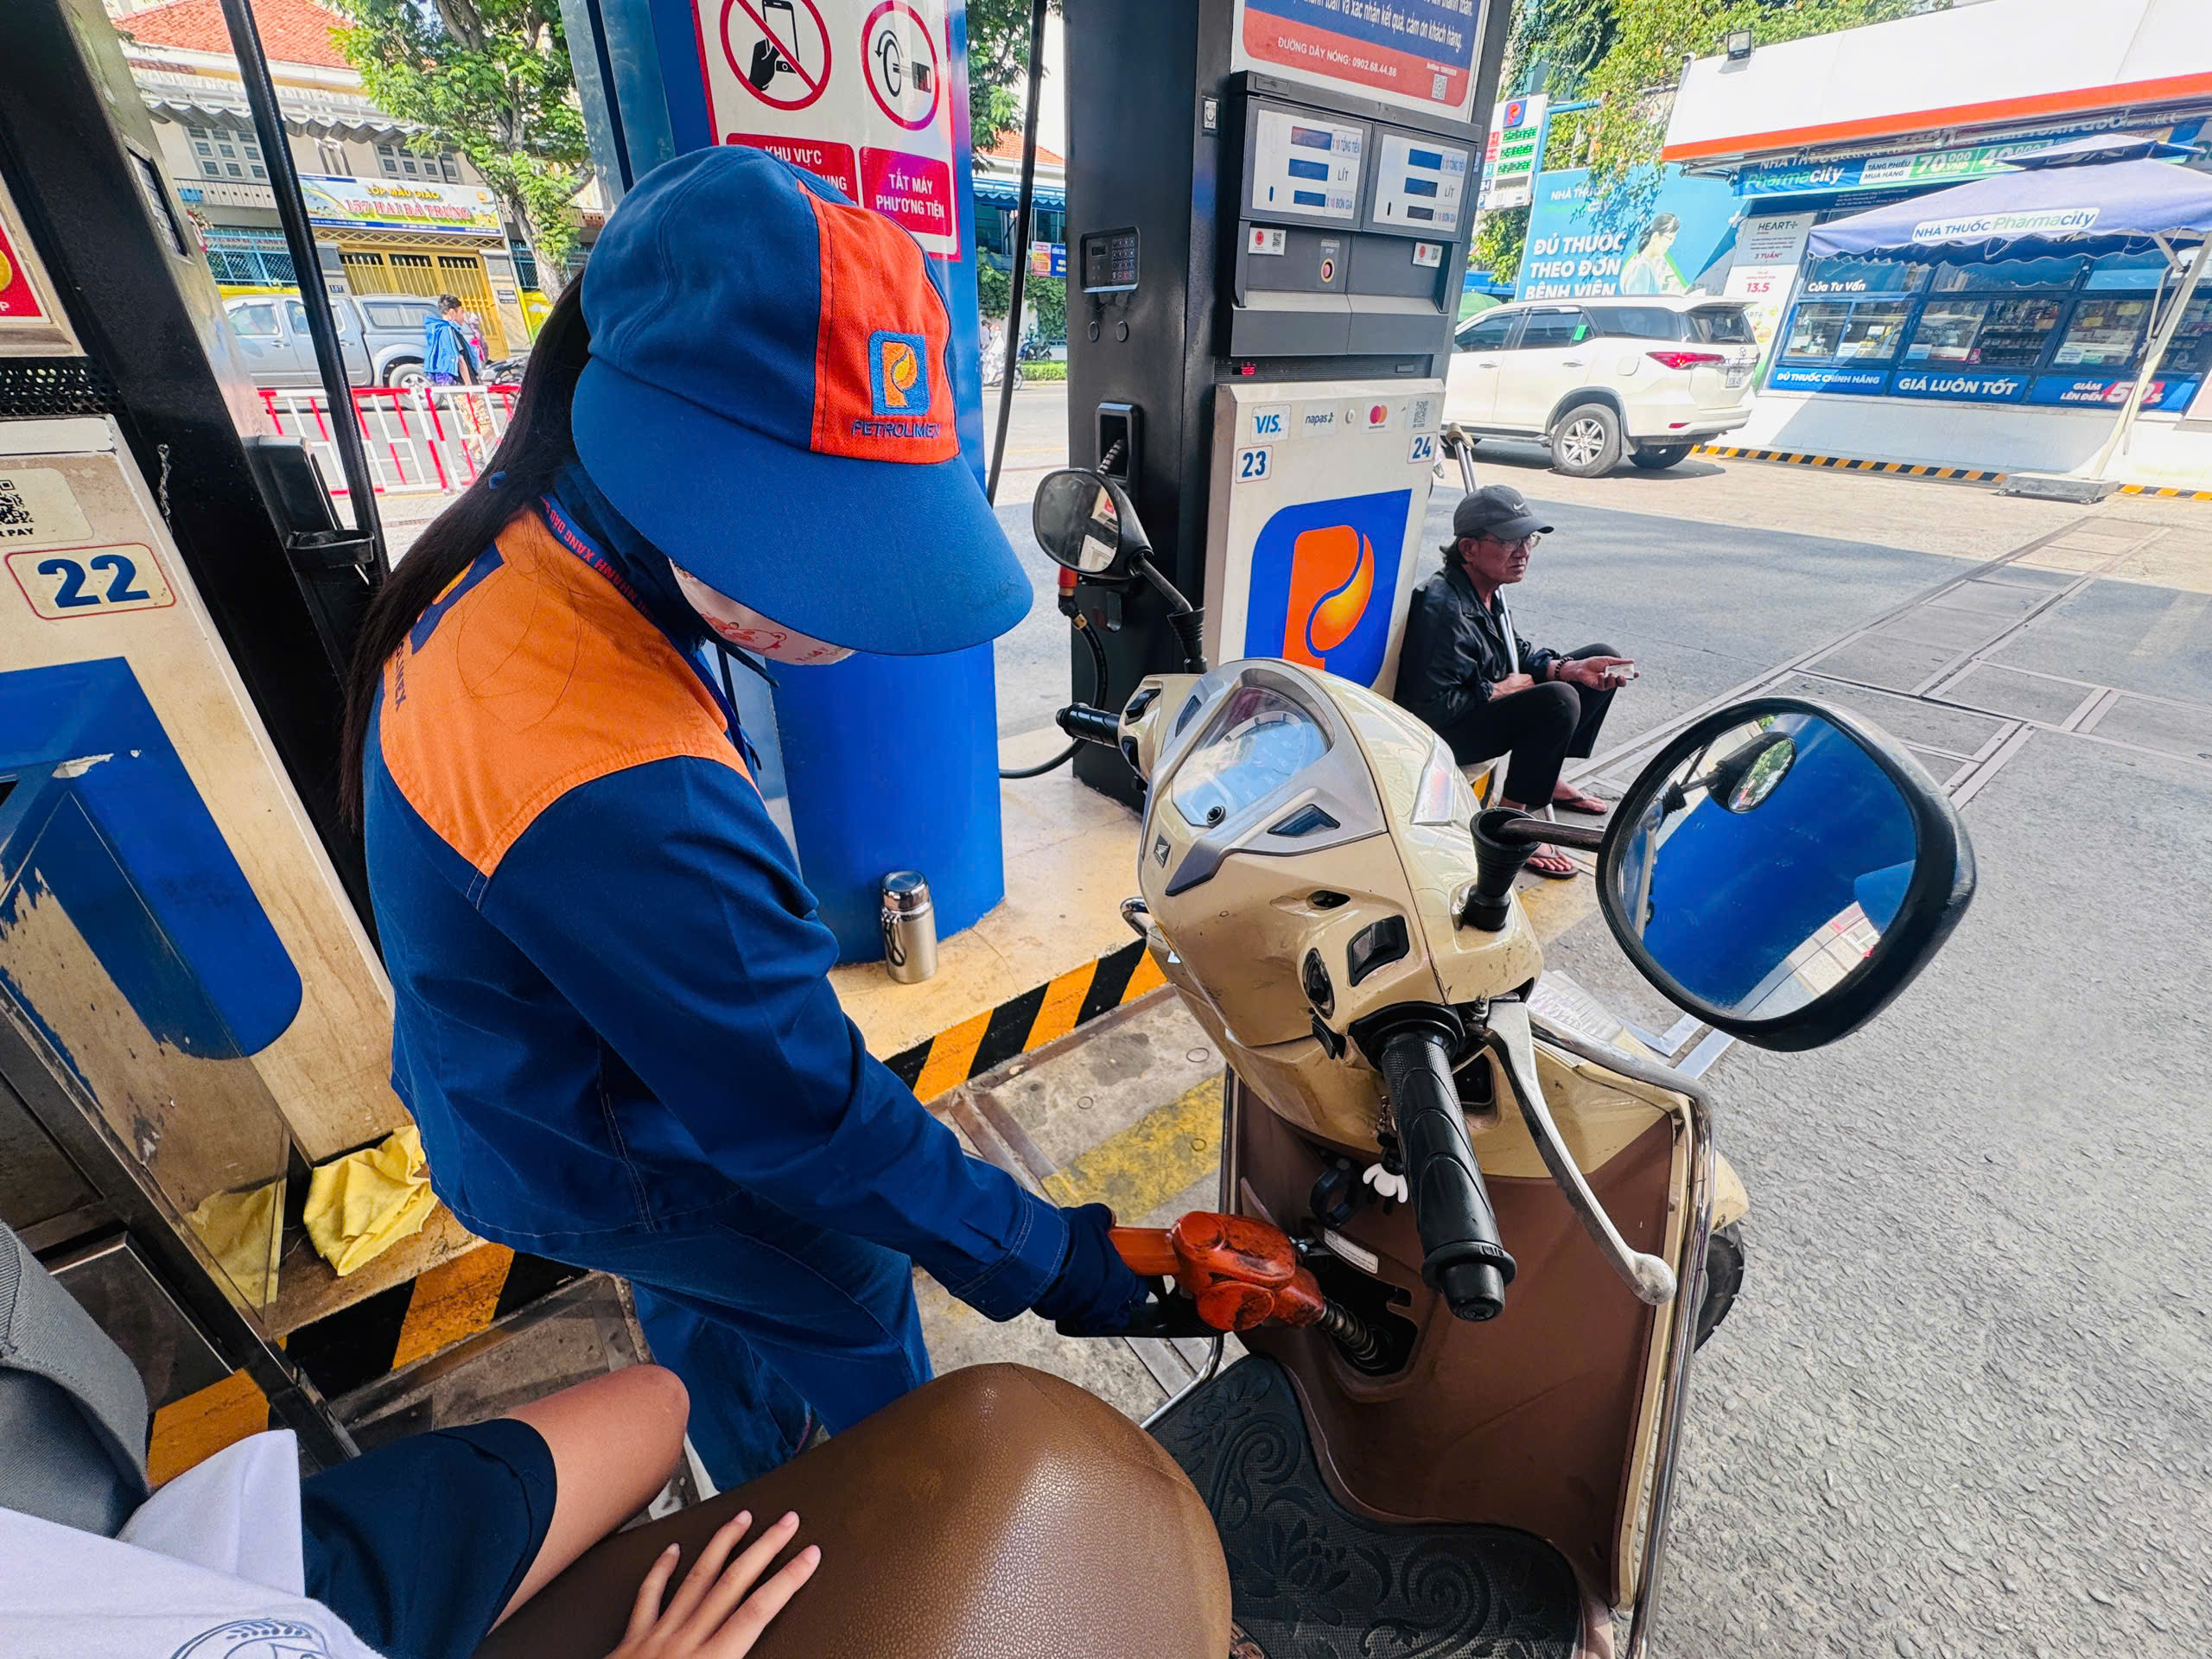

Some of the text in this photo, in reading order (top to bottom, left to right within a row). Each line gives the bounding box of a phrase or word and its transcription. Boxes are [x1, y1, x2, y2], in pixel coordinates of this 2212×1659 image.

[792, 149, 822, 164] VỰC
[1916, 154, 1947, 174] 70
[887, 168, 933, 194] TẮT MÁY
[1745, 165, 1846, 188] Pharmacity
[346, 199, 370, 213] 157
[372, 200, 403, 216] HAI
[875, 194, 945, 220] PHƯƠNG TIỆN
[1914, 210, 2096, 238] NHÀ THUỐC Pharmacity
[1533, 229, 1627, 256] ĐỦ THUỐC
[1529, 257, 1623, 278] THEO ĐƠN
[1745, 282, 1770, 293] 13.5
[1808, 278, 1866, 293] Cửa Tư Vấn
[1898, 372, 2019, 396] GIÁ LUÔN TỐT
[2059, 391, 2081, 401] LÊN
[1254, 414, 1282, 434] VIS
[1305, 414, 1328, 427] napas
[1412, 436, 1432, 460] 24
[1242, 450, 1267, 478] 23
[7, 527, 35, 537] PAY
[37, 554, 151, 608] 22
